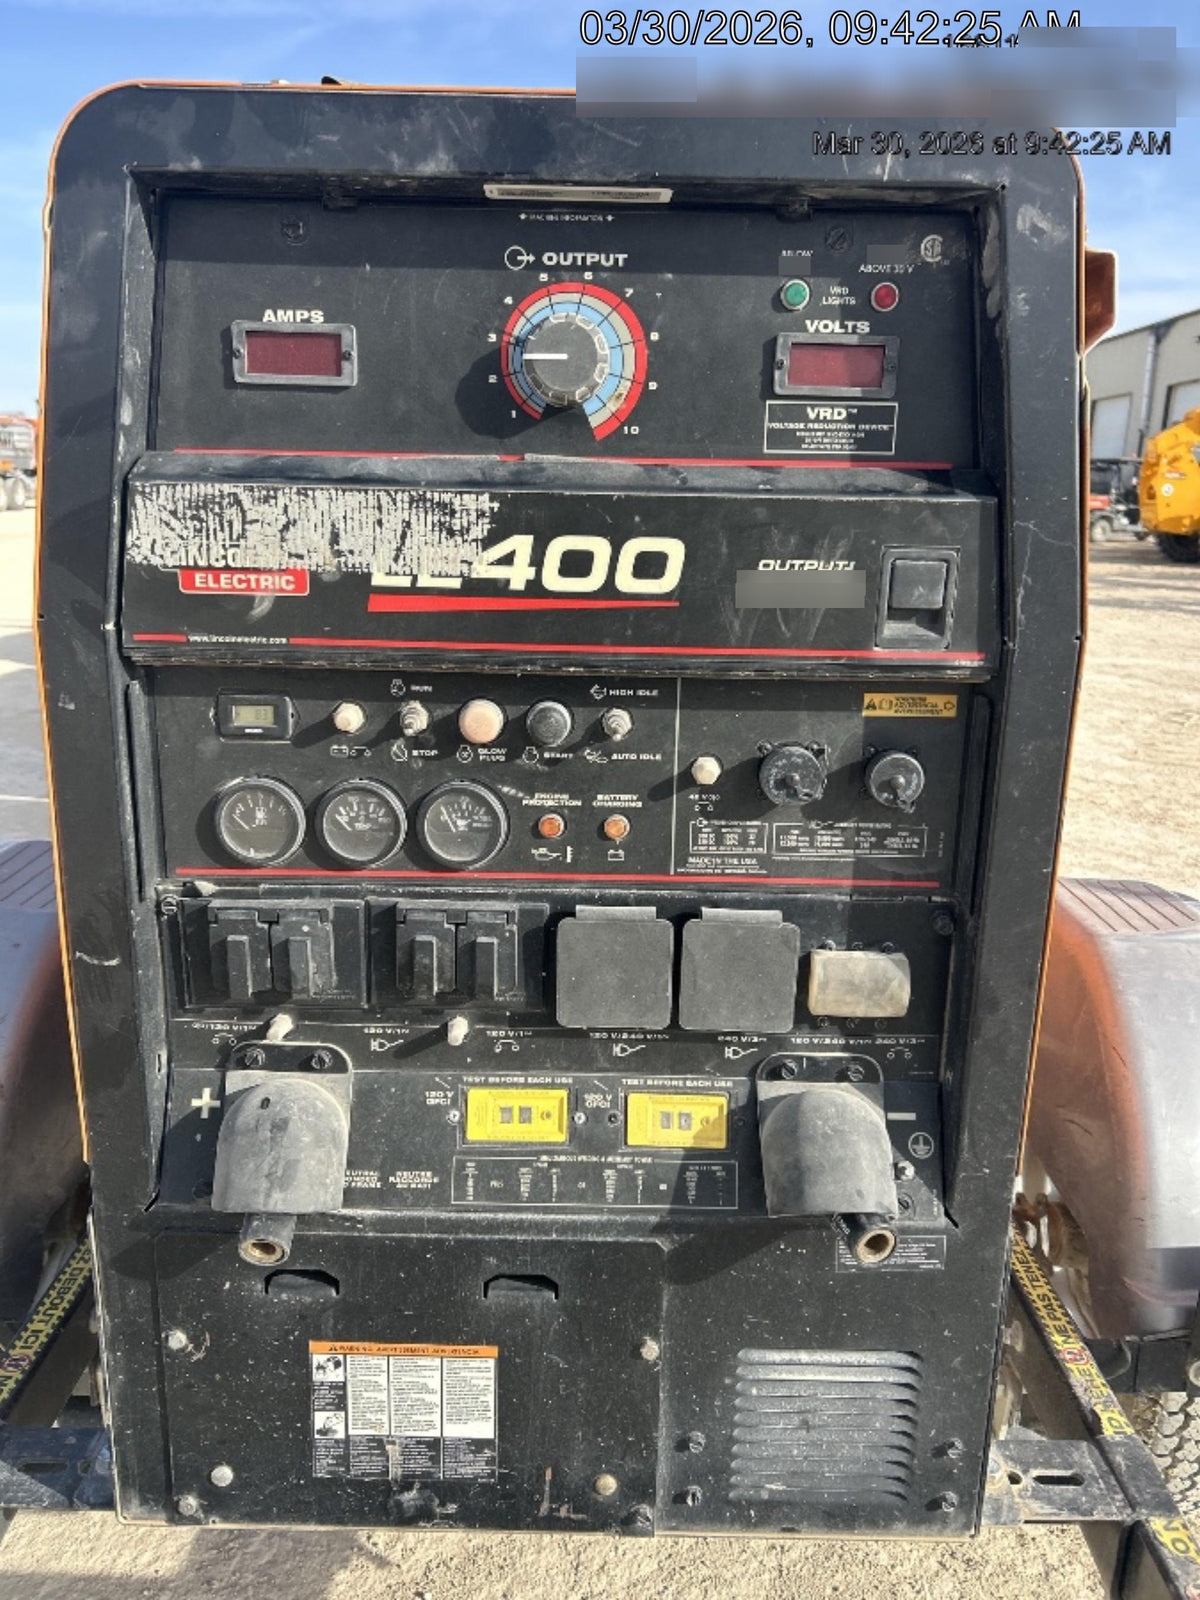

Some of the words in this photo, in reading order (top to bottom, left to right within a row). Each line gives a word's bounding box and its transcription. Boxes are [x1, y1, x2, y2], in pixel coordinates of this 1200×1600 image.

[542, 252, 628, 267] OUTPUT
[858, 264, 892, 273] ABOVE
[625, 288, 634, 298] 7
[829, 286, 849, 295] VRD
[504, 296, 513, 305] 4
[822, 296, 856, 305] LIGHTS
[262, 309, 325, 323] AMPS
[805, 319, 871, 334] VOLTS
[487, 334, 497, 342] 3
[511, 410, 517, 418] 1
[623, 426, 639, 434] 10
[194, 573, 296, 591] ELECTRIC
[412, 749, 439, 757] STOP
[639, 753, 662, 761] IDLE
[488, 1076, 525, 1084] BEFORE
[621, 1078, 645, 1086] TEST
[646, 1079, 684, 1087] BEFORE
[1012, 1245, 1045, 1288] TENEZ
[37, 1266, 85, 1327] DEBOUT
[1037, 1293, 1066, 1324] PAS
[1054, 1323, 1079, 1345] NE
[19, 1329, 45, 1350] ICI
